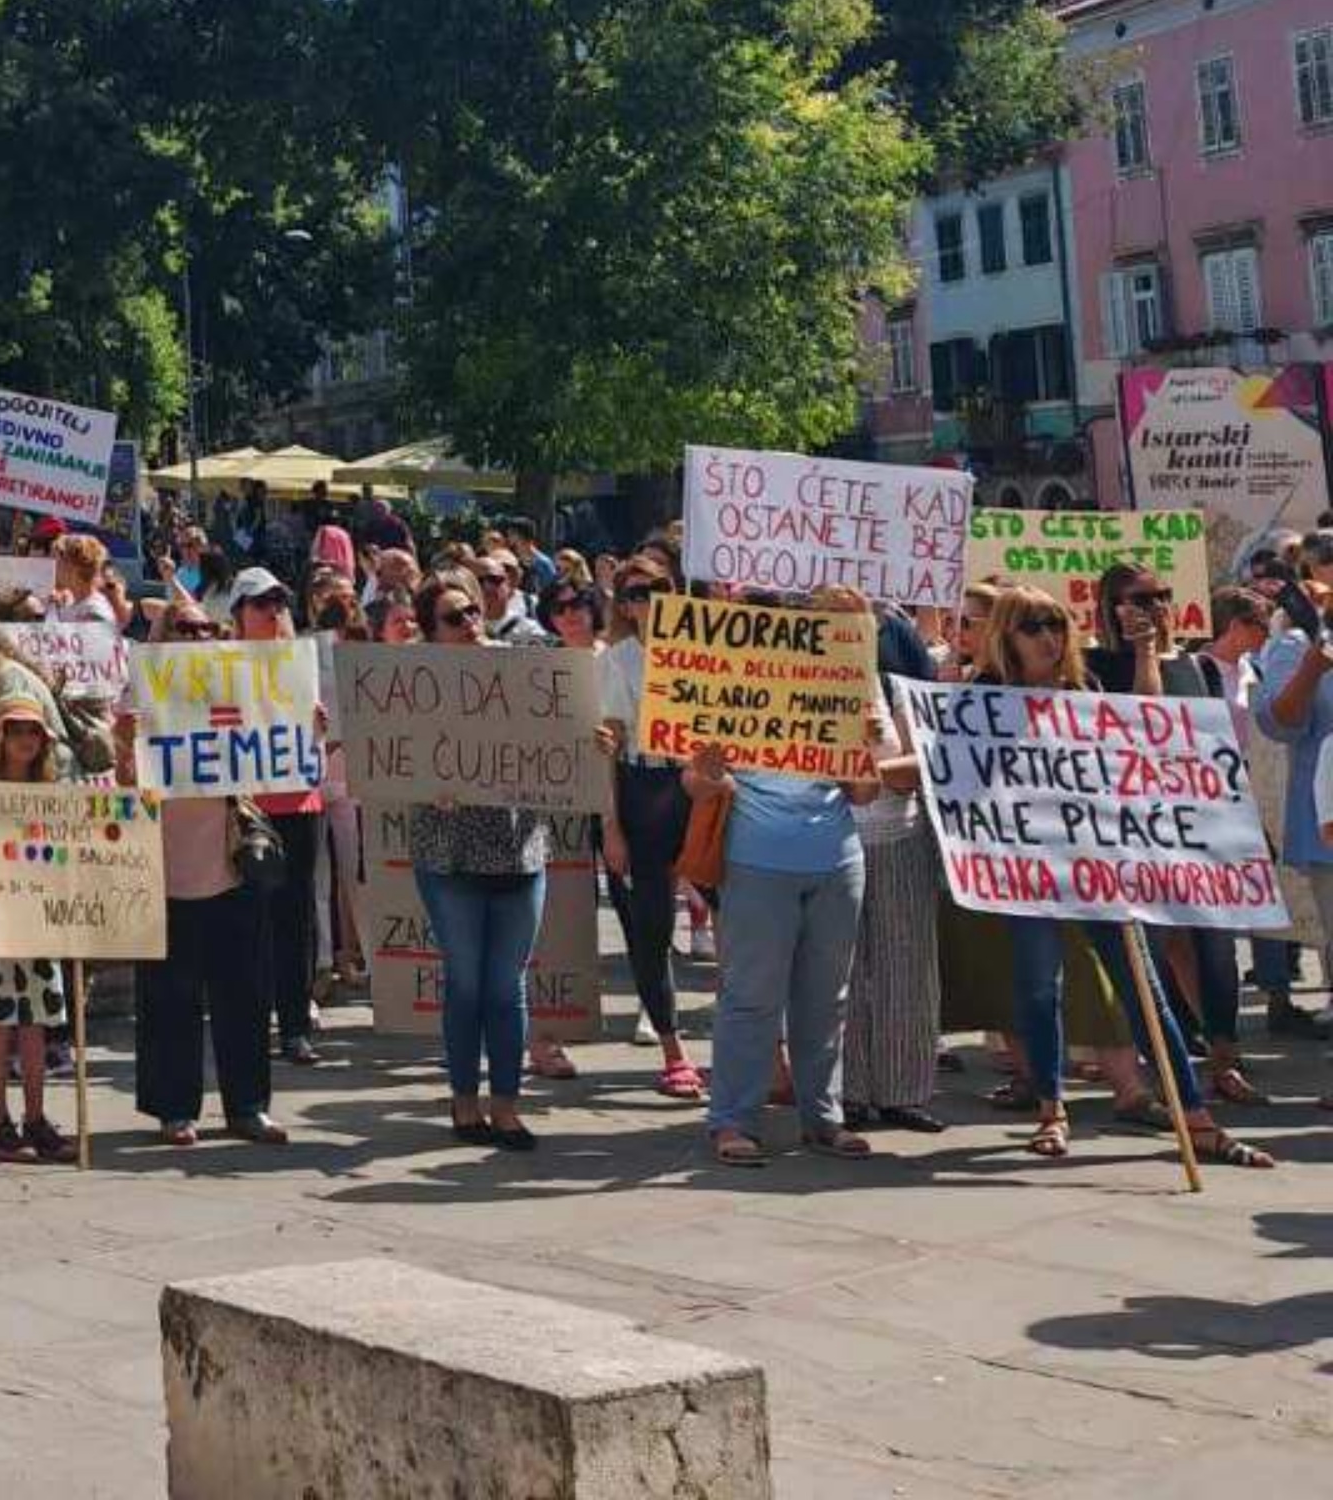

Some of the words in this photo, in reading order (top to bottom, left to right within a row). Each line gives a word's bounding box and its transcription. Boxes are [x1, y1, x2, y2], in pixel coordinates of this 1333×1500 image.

[3, 440, 107, 480] ZANIMANJE
[1140, 422, 1252, 449] Istarski
[1166, 447, 1244, 470] kanti
[704, 455, 765, 498] ŠTO
[797, 465, 881, 516] ĆETE
[903, 484, 965, 526] KAD
[718, 503, 887, 553] OSTANETE
[911, 525, 965, 563] BEZ
[1142, 513, 1202, 542] KAD
[652, 599, 829, 655] LAVORARE
[354, 664, 441, 716] KAO
[460, 666, 510, 718] DA
[529, 666, 574, 718] SE
[910, 687, 1015, 739] NEĆE
[1024, 695, 1195, 746] MLADI
[692, 713, 839, 743] ENORME
[148, 724, 322, 788] TEMELJ
[367, 736, 414, 779] NE
[927, 746, 953, 786] U
[937, 799, 1040, 846] MALE
[1060, 803, 1208, 850] PLAĆE
[950, 852, 1061, 901] VELIKA
[1072, 858, 1279, 907] ODGOVORNOST
